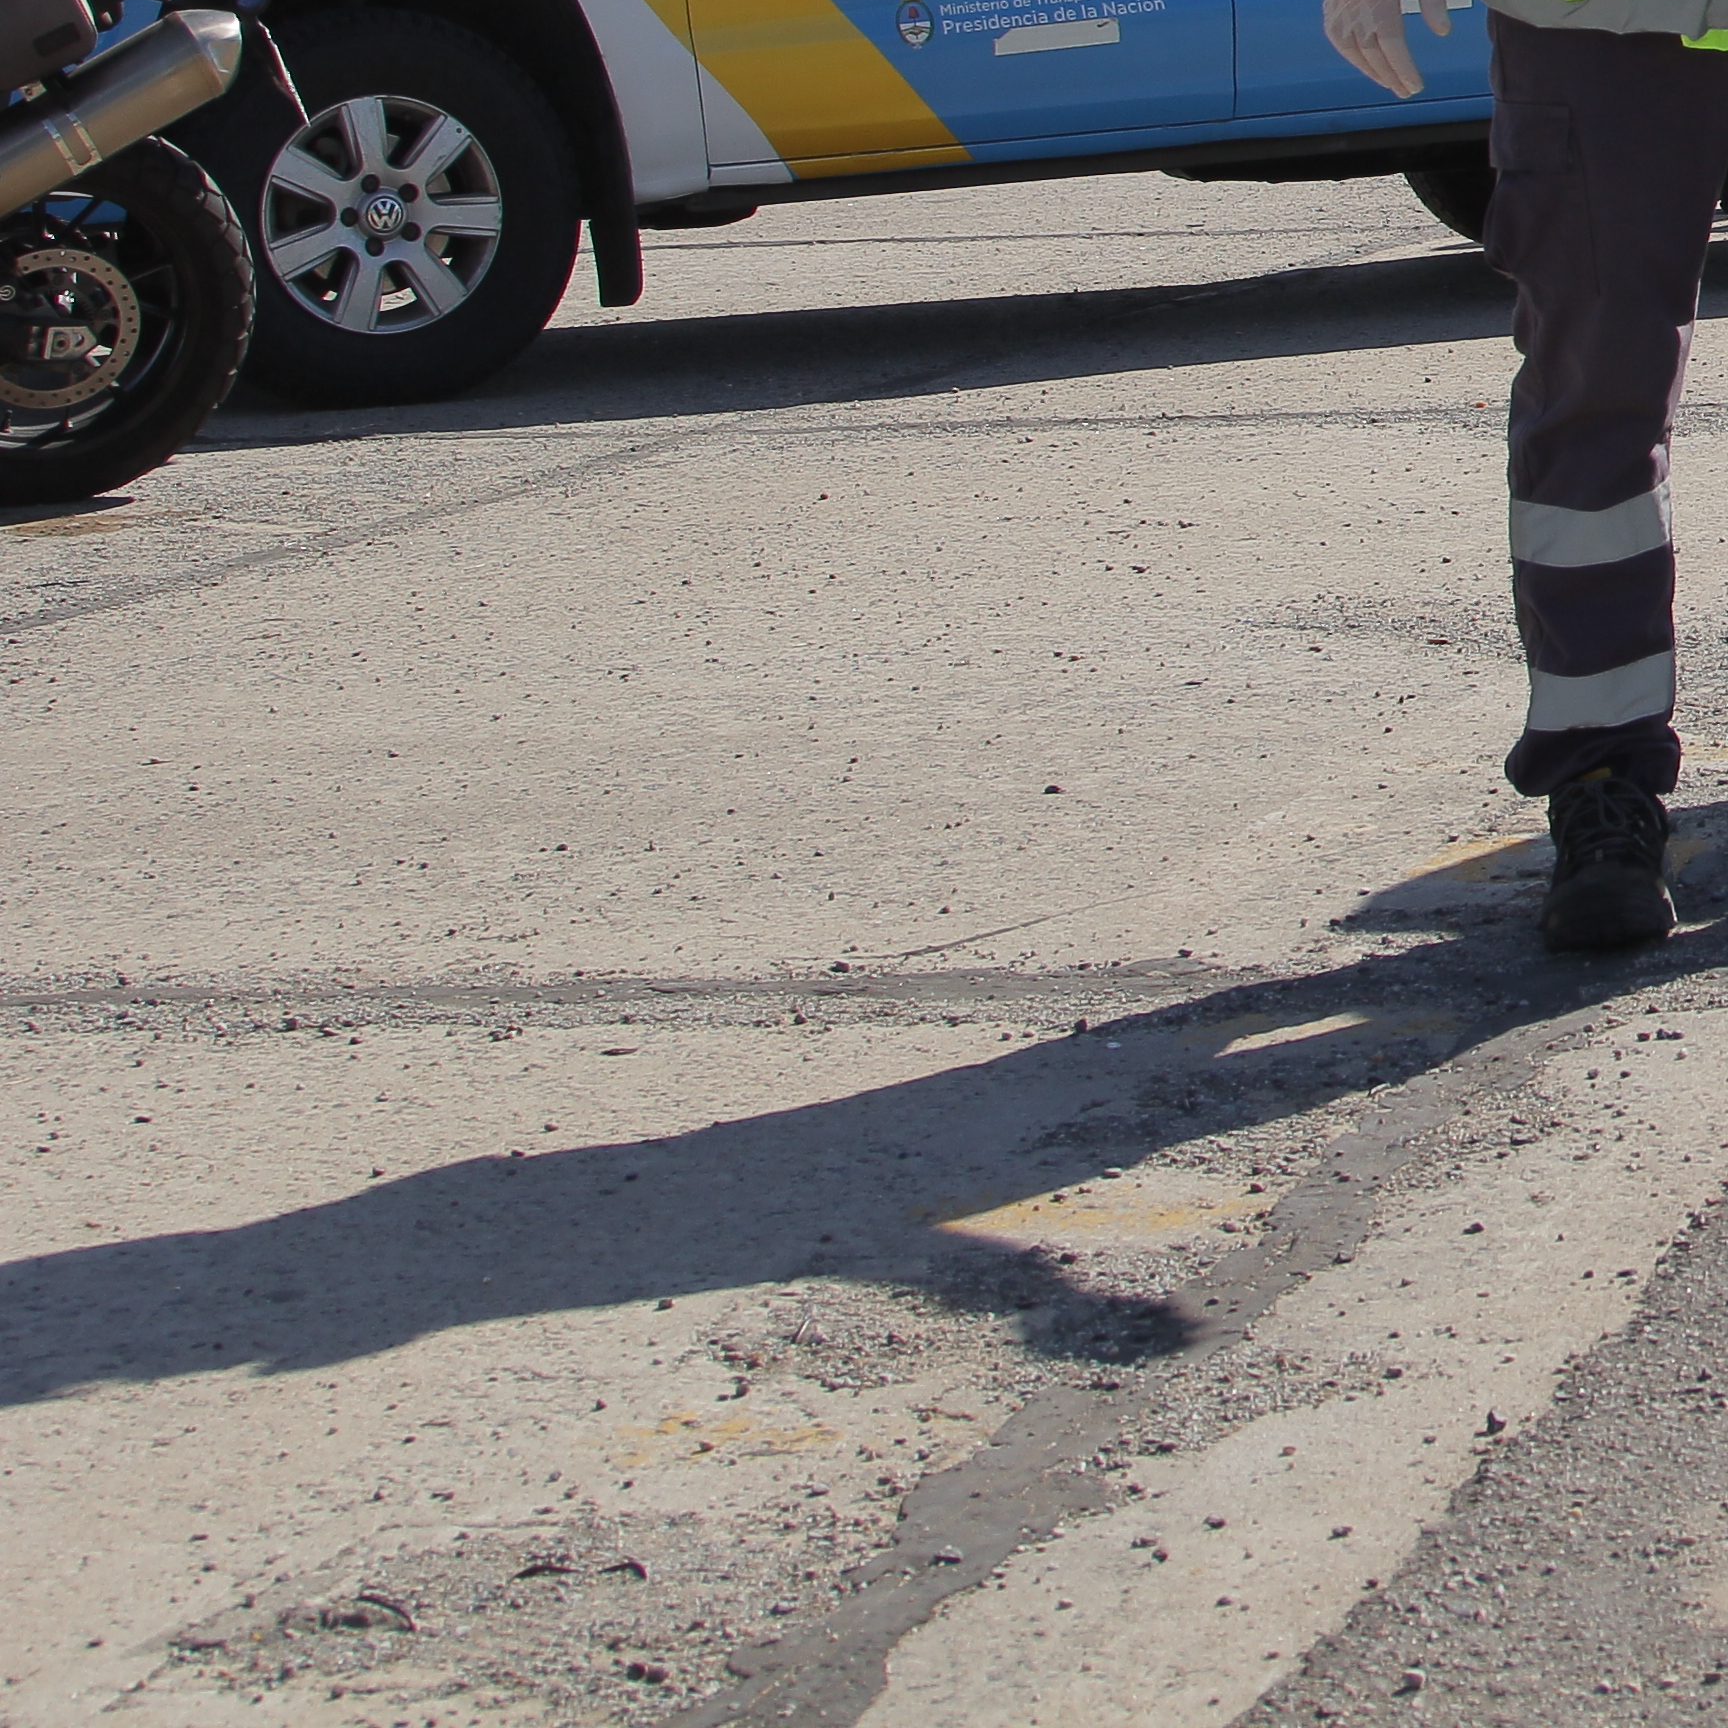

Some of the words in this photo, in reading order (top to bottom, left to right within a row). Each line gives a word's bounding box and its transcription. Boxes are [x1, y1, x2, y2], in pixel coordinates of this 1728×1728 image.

[939, 0, 1009, 16] Ministerio
[942, 10, 1049, 34] Presidencia
[1054, 6, 1076, 21] de
[1081, 4, 1097, 18] la
